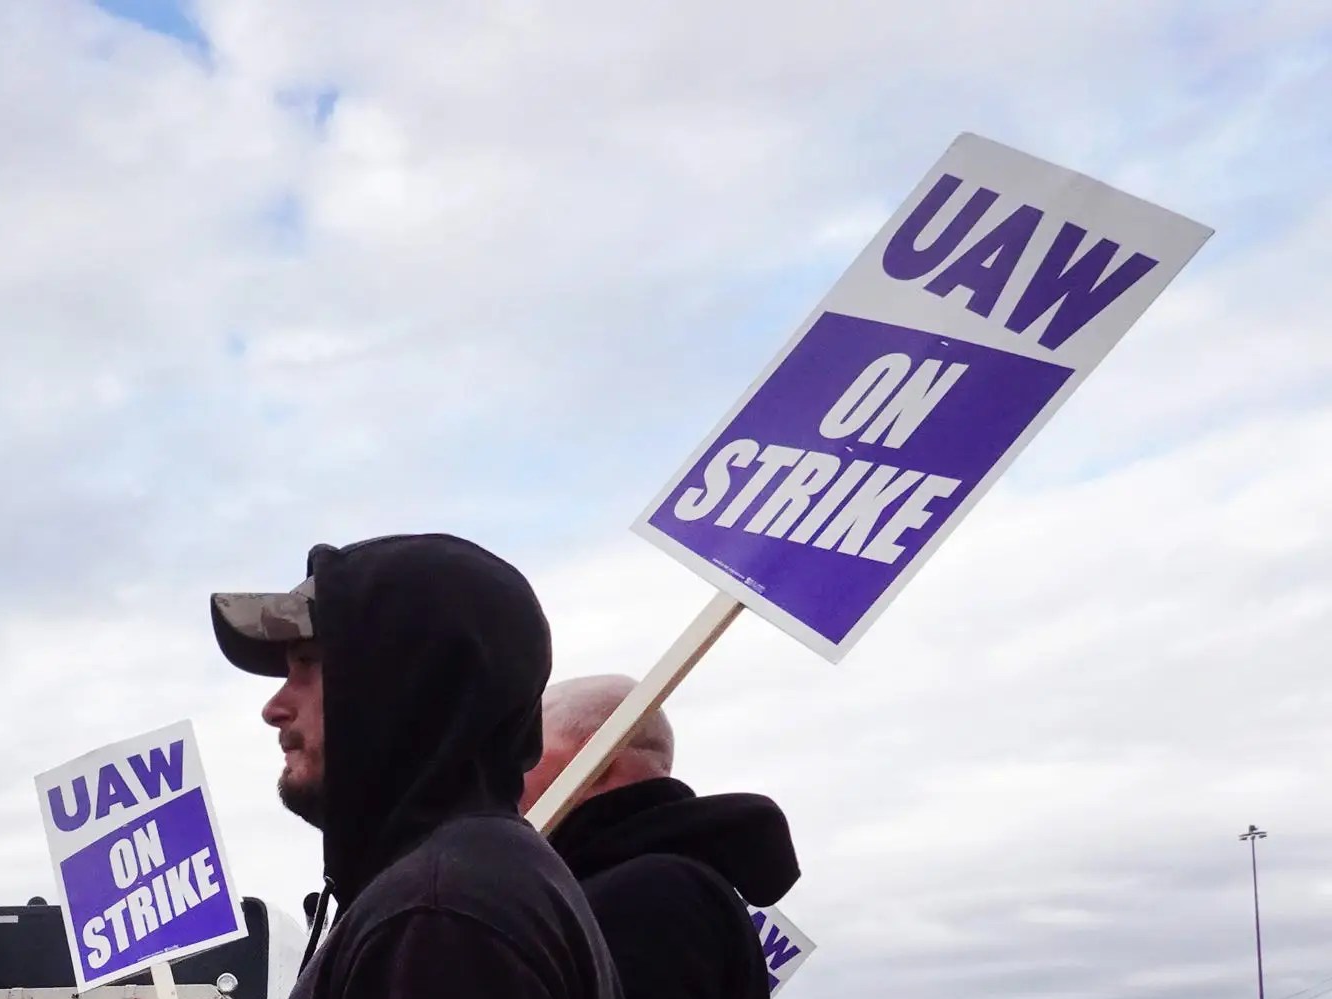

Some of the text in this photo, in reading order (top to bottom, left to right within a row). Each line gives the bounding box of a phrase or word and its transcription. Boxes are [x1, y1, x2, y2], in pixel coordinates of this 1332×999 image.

[882, 172, 1159, 351] UAW
[819, 352, 969, 449] ON
[674, 438, 962, 564] STRIKE
[47, 739, 184, 832] UAW
[82, 846, 221, 969] STRIKE
[108, 819, 166, 890] ON
